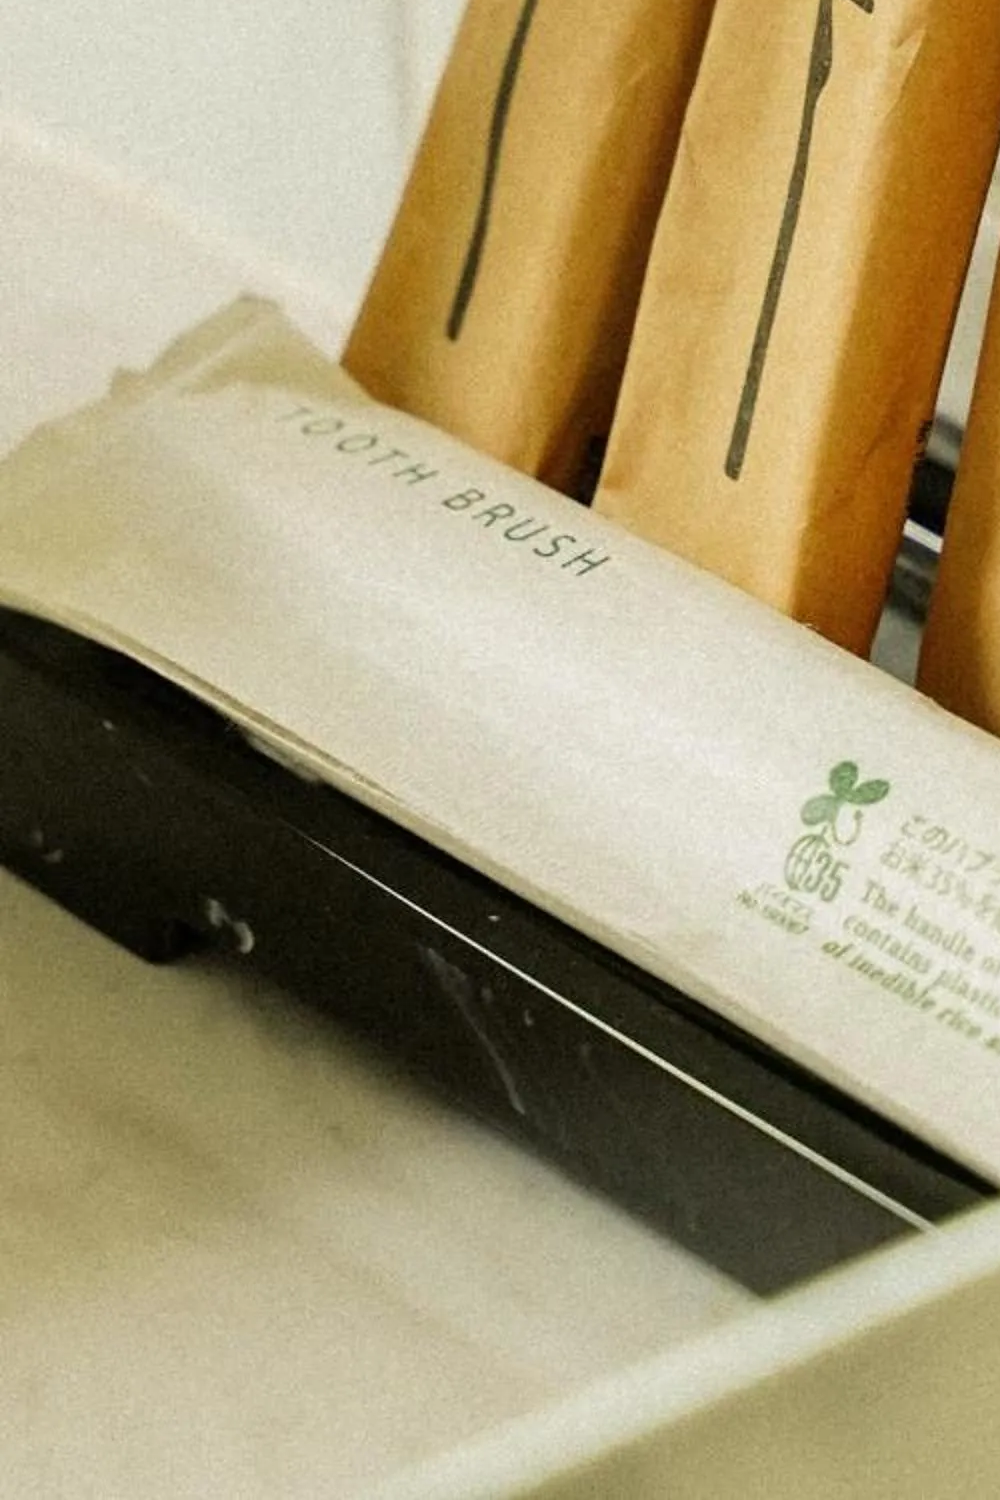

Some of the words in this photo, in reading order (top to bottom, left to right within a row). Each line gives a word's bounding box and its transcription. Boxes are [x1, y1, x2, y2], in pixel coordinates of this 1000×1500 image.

[275, 405, 440, 486] TOOTH
[441, 487, 611, 577] BRUSH
[843, 913, 932, 974] contains
[860, 879, 901, 918] The
[903, 905, 977, 962] handle
[847, 953, 937, 1012] inedible
